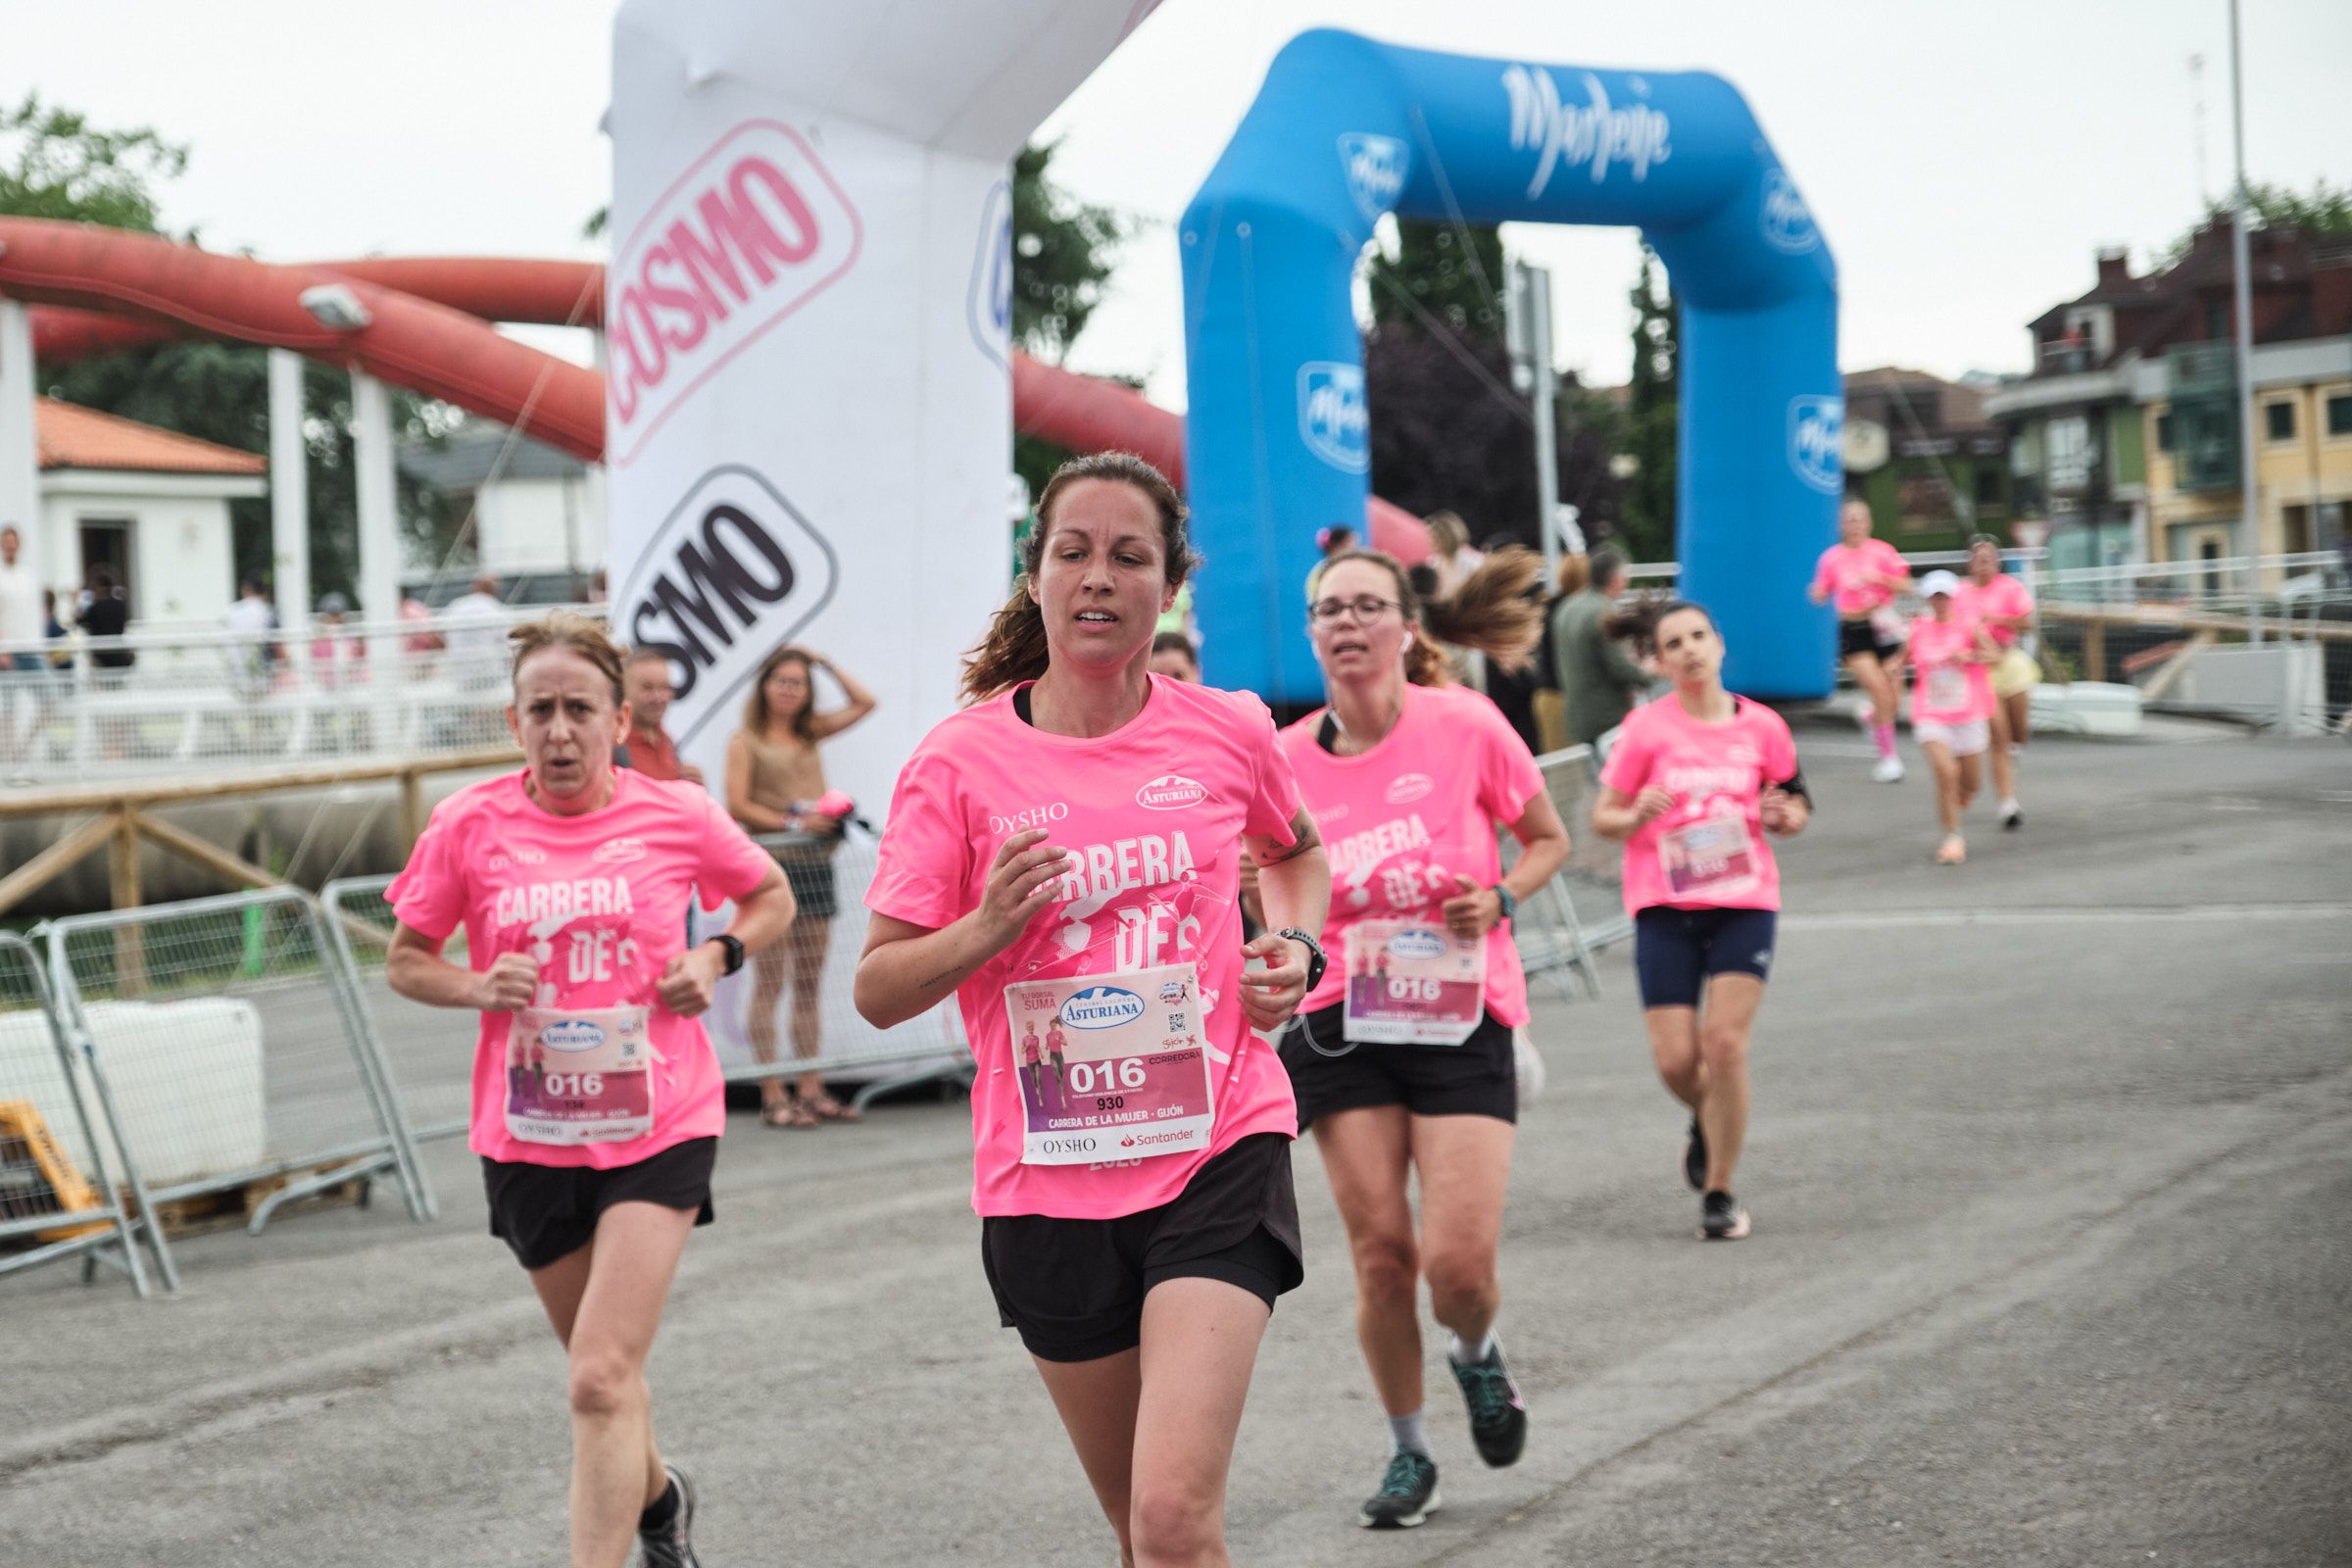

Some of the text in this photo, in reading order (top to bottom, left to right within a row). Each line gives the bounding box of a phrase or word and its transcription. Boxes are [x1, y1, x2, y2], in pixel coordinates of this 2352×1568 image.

[609, 157, 820, 425] COSMO
[633, 505, 795, 701] SMO
[1144, 789, 1202, 805] ASTURIANA
[989, 802, 1068, 835] OYSHO
[1327, 812, 1432, 876] ARRERA
[1030, 830, 1199, 904] RRERA
[1389, 976, 1442, 1001] 016
[1024, 998, 1056, 1010] SUMA
[1066, 1003, 1139, 1021] ASTURIANA
[1149, 1052, 1200, 1065] CORREDORA
[545, 1072, 604, 1097] 016
[1070, 1057, 1147, 1093] 016
[1097, 1096, 1124, 1110] 930
[1049, 1104, 1184, 1129] CARRERA DE LA MUJER GIJÓN
[1043, 1138, 1097, 1153] OYSHO
[1137, 1129, 1195, 1146] Santander
